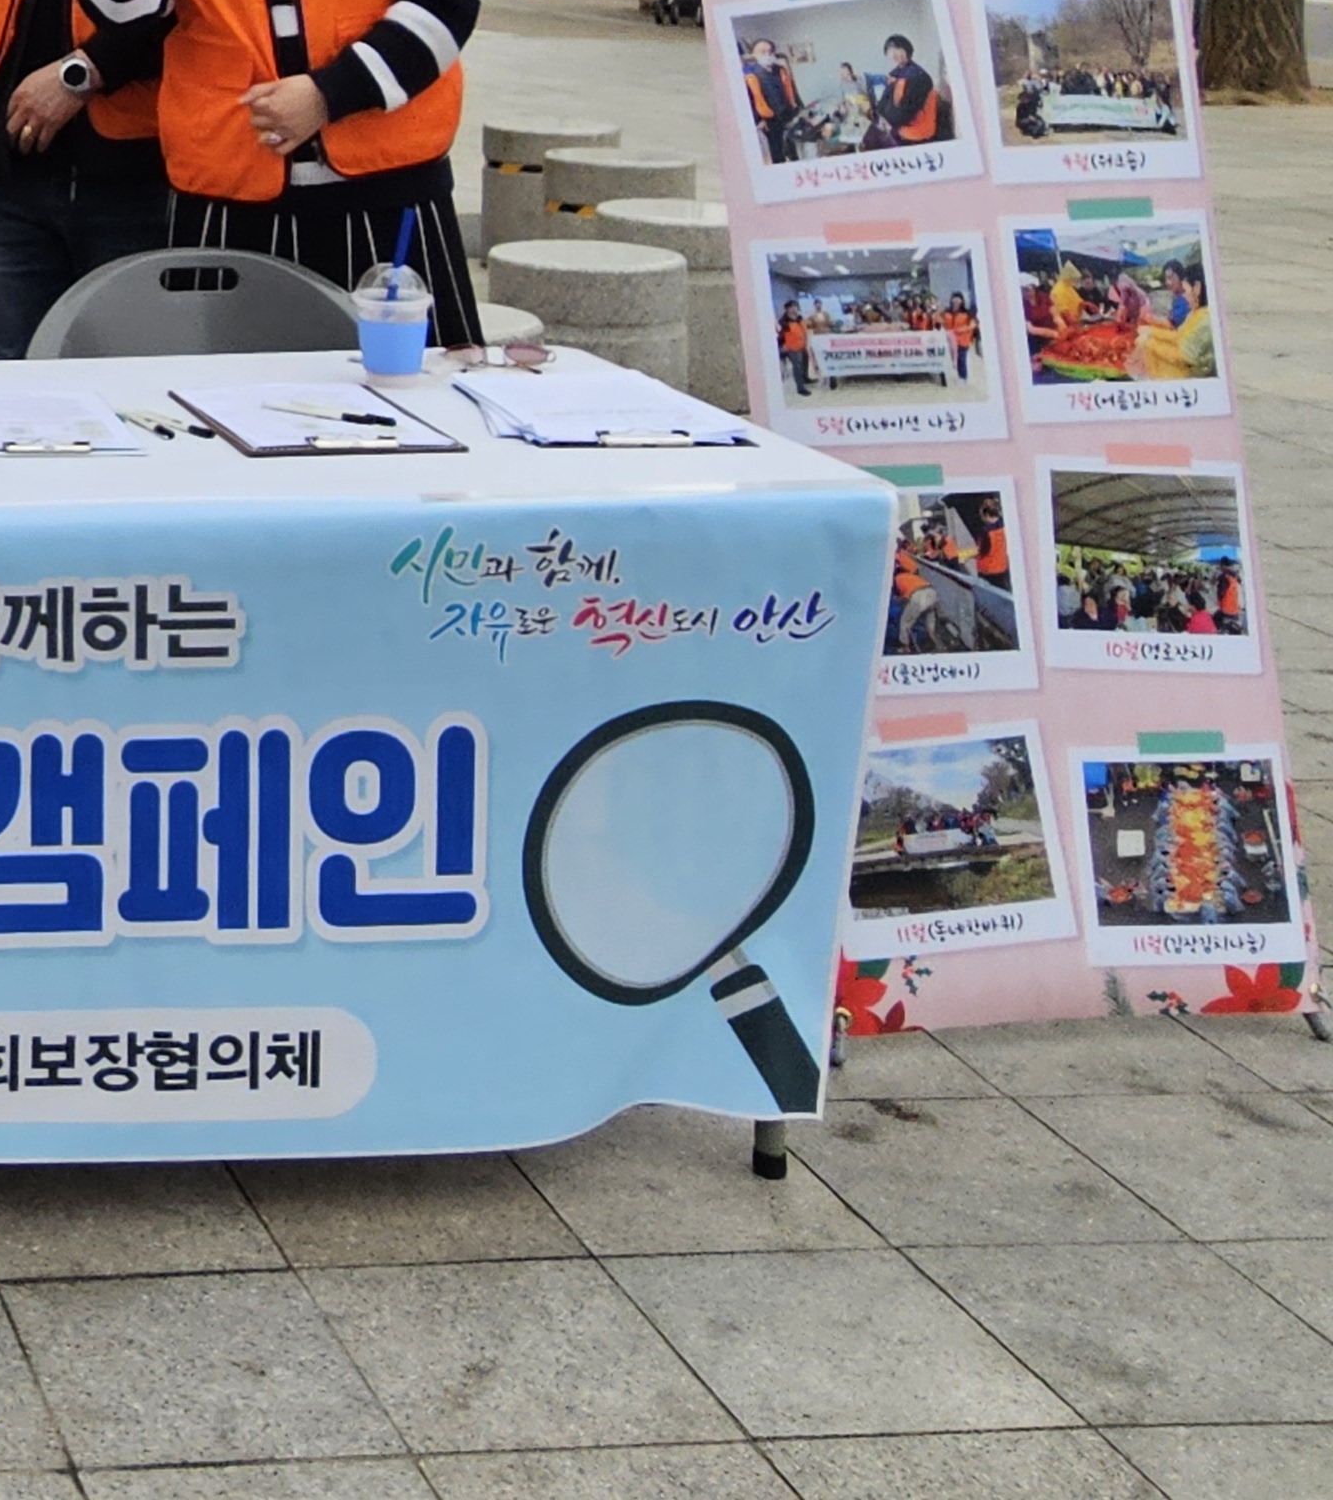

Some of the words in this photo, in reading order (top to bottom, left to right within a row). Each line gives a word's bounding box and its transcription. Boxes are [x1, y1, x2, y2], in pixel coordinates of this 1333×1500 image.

[1164, 387, 1199, 409] 나눔)
[927, 410, 966, 433] 나눔)
[390, 527, 524, 604] 시민과
[429, 601, 559, 664] 자유로운
[572, 596, 720, 656] 혁신도시
[733, 591, 836, 644] 안산
[878, 662, 981, 686] 월(클린업데이)
